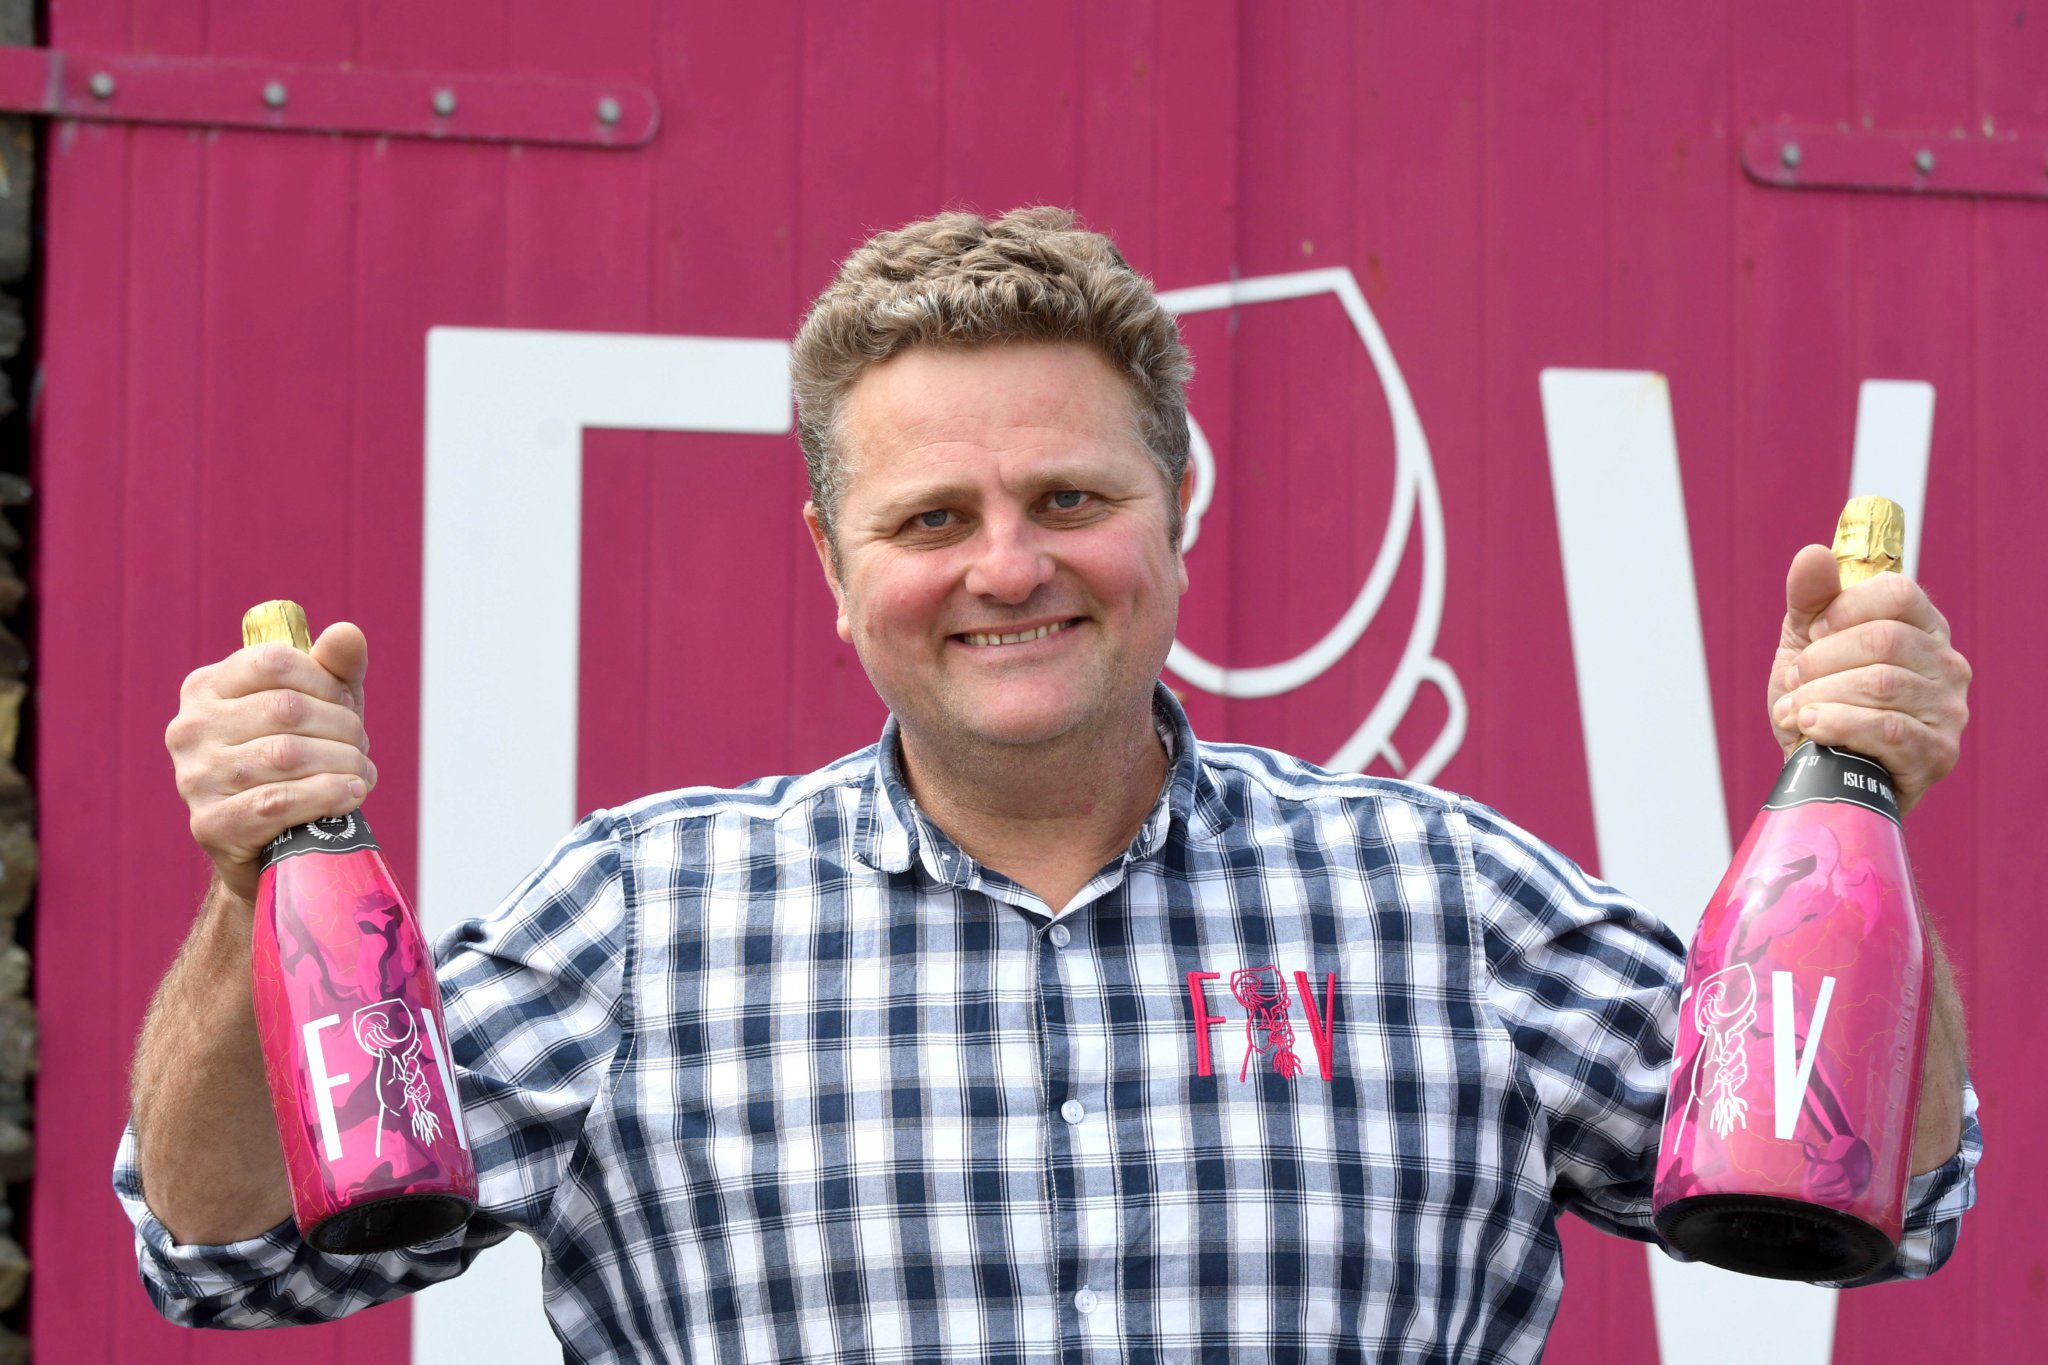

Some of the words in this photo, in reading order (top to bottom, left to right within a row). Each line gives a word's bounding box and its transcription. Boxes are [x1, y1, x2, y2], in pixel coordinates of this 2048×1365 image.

[1784, 755, 1820, 794] 1ST
[1843, 772, 1865, 789] ISLE
[1867, 777, 1877, 793] OF
